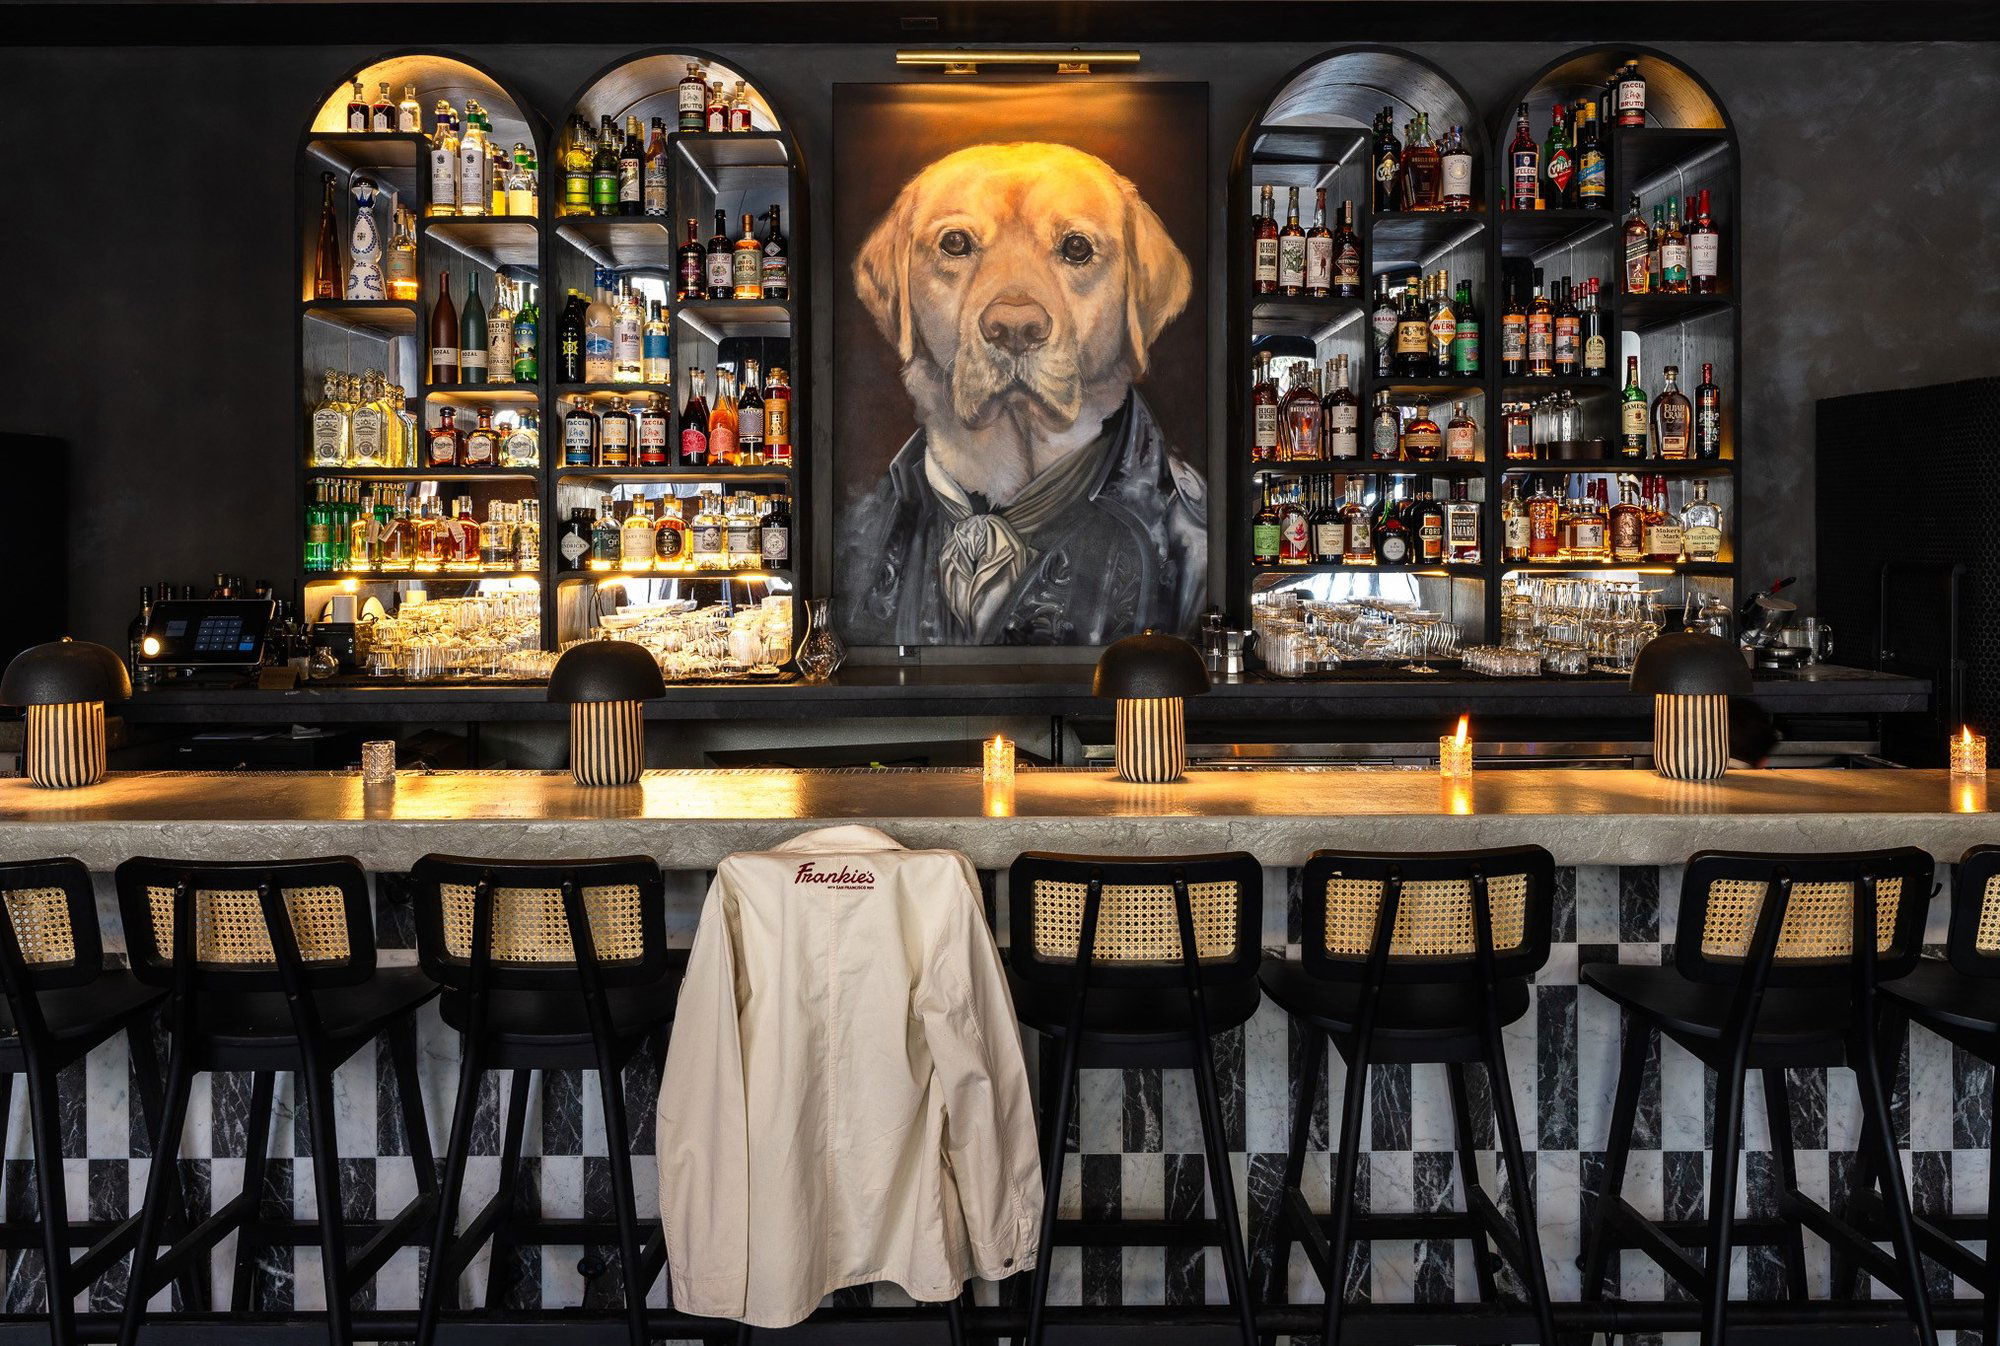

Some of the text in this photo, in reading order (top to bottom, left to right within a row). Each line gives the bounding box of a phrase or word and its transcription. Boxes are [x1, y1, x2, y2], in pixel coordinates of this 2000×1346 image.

[1664, 404, 1685, 412] ELIJAH
[1452, 526, 1474, 537] AMARO
[795, 862, 875, 884] Frankie's
